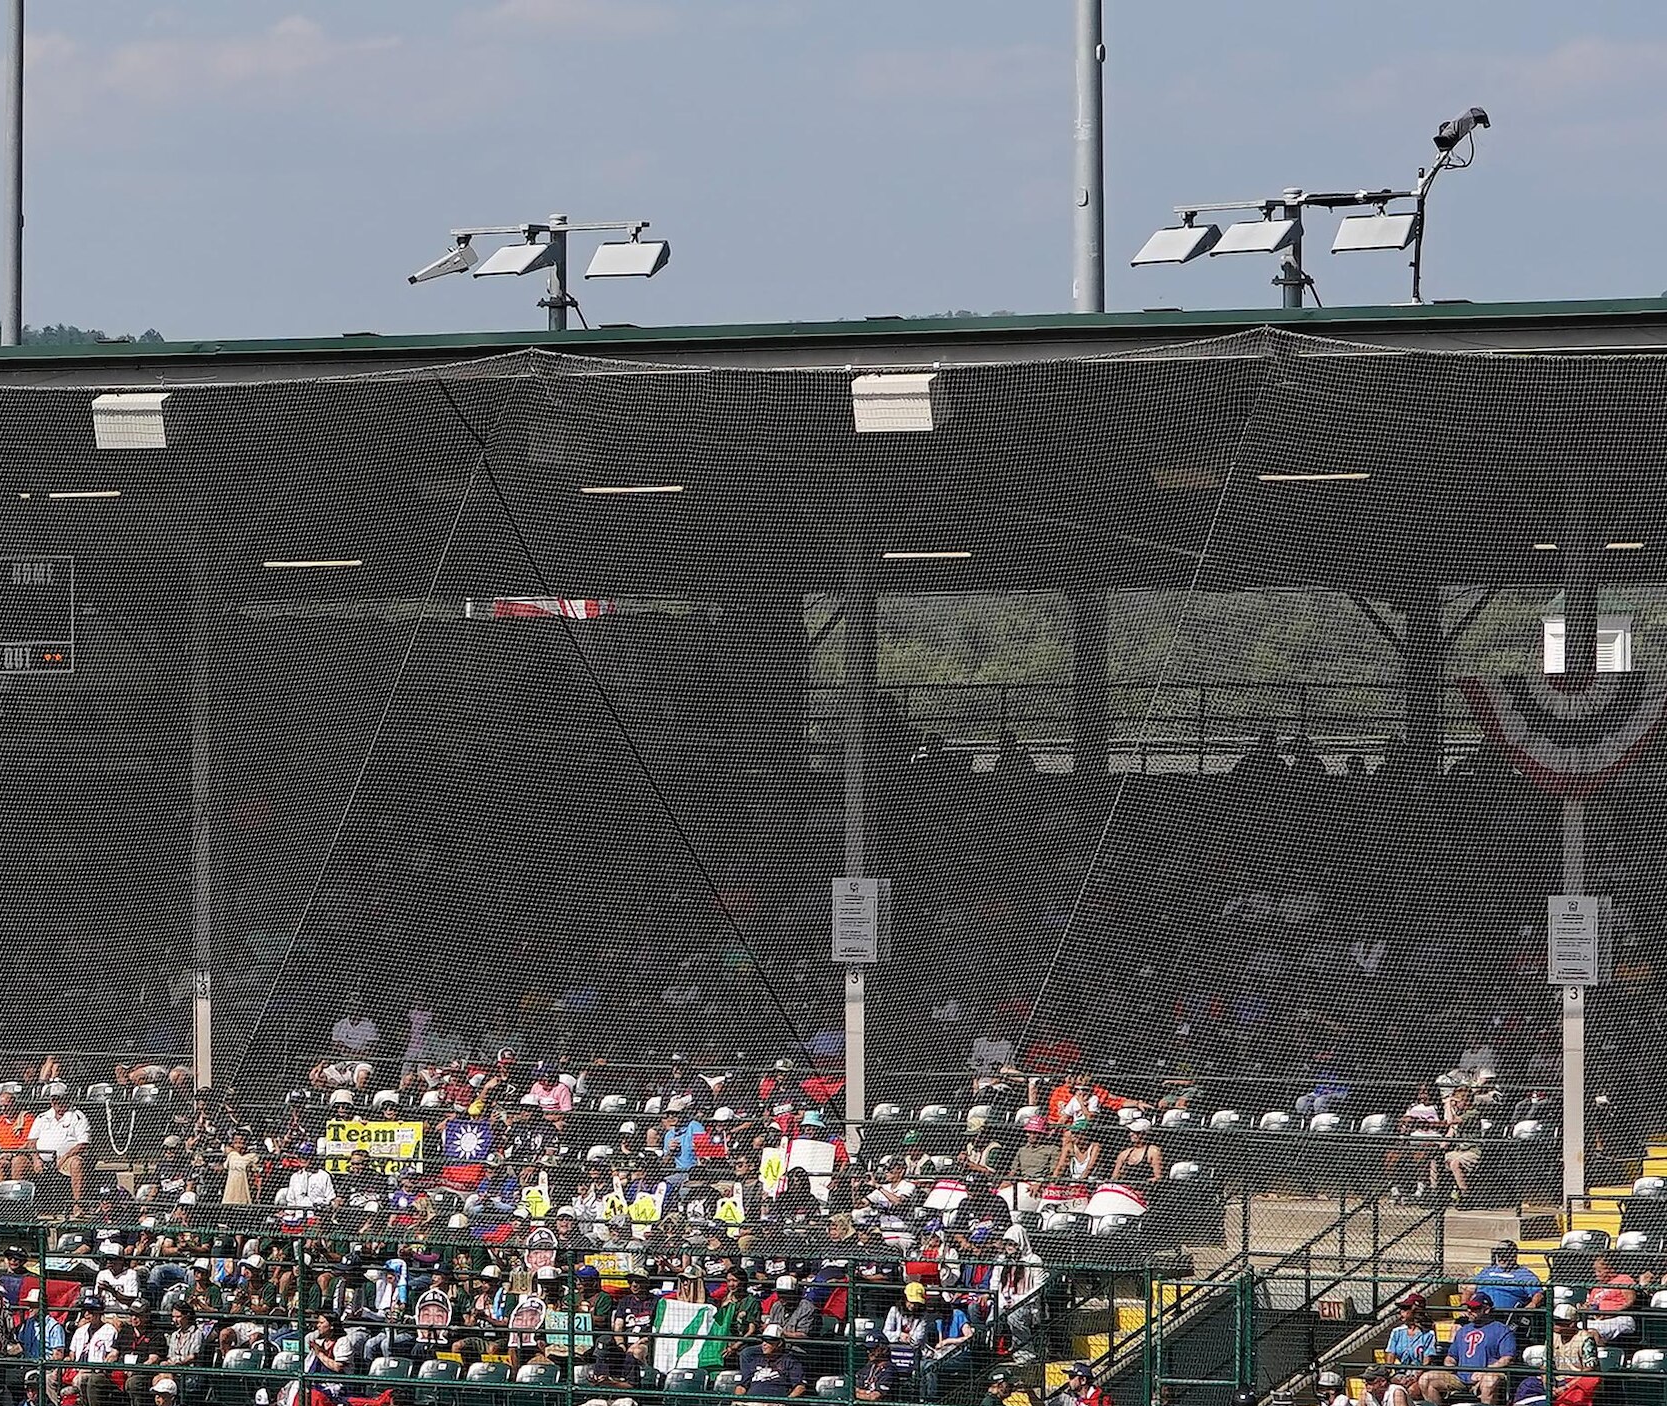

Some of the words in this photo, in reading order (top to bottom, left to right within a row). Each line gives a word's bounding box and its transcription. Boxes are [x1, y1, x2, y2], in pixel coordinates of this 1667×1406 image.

[11, 562, 54, 585] HOME
[3, 646, 32, 669] OUT
[1569, 986, 1579, 1000] 3
[327, 1123, 395, 1143] Team
[1319, 1300, 1343, 1320] EXIT
